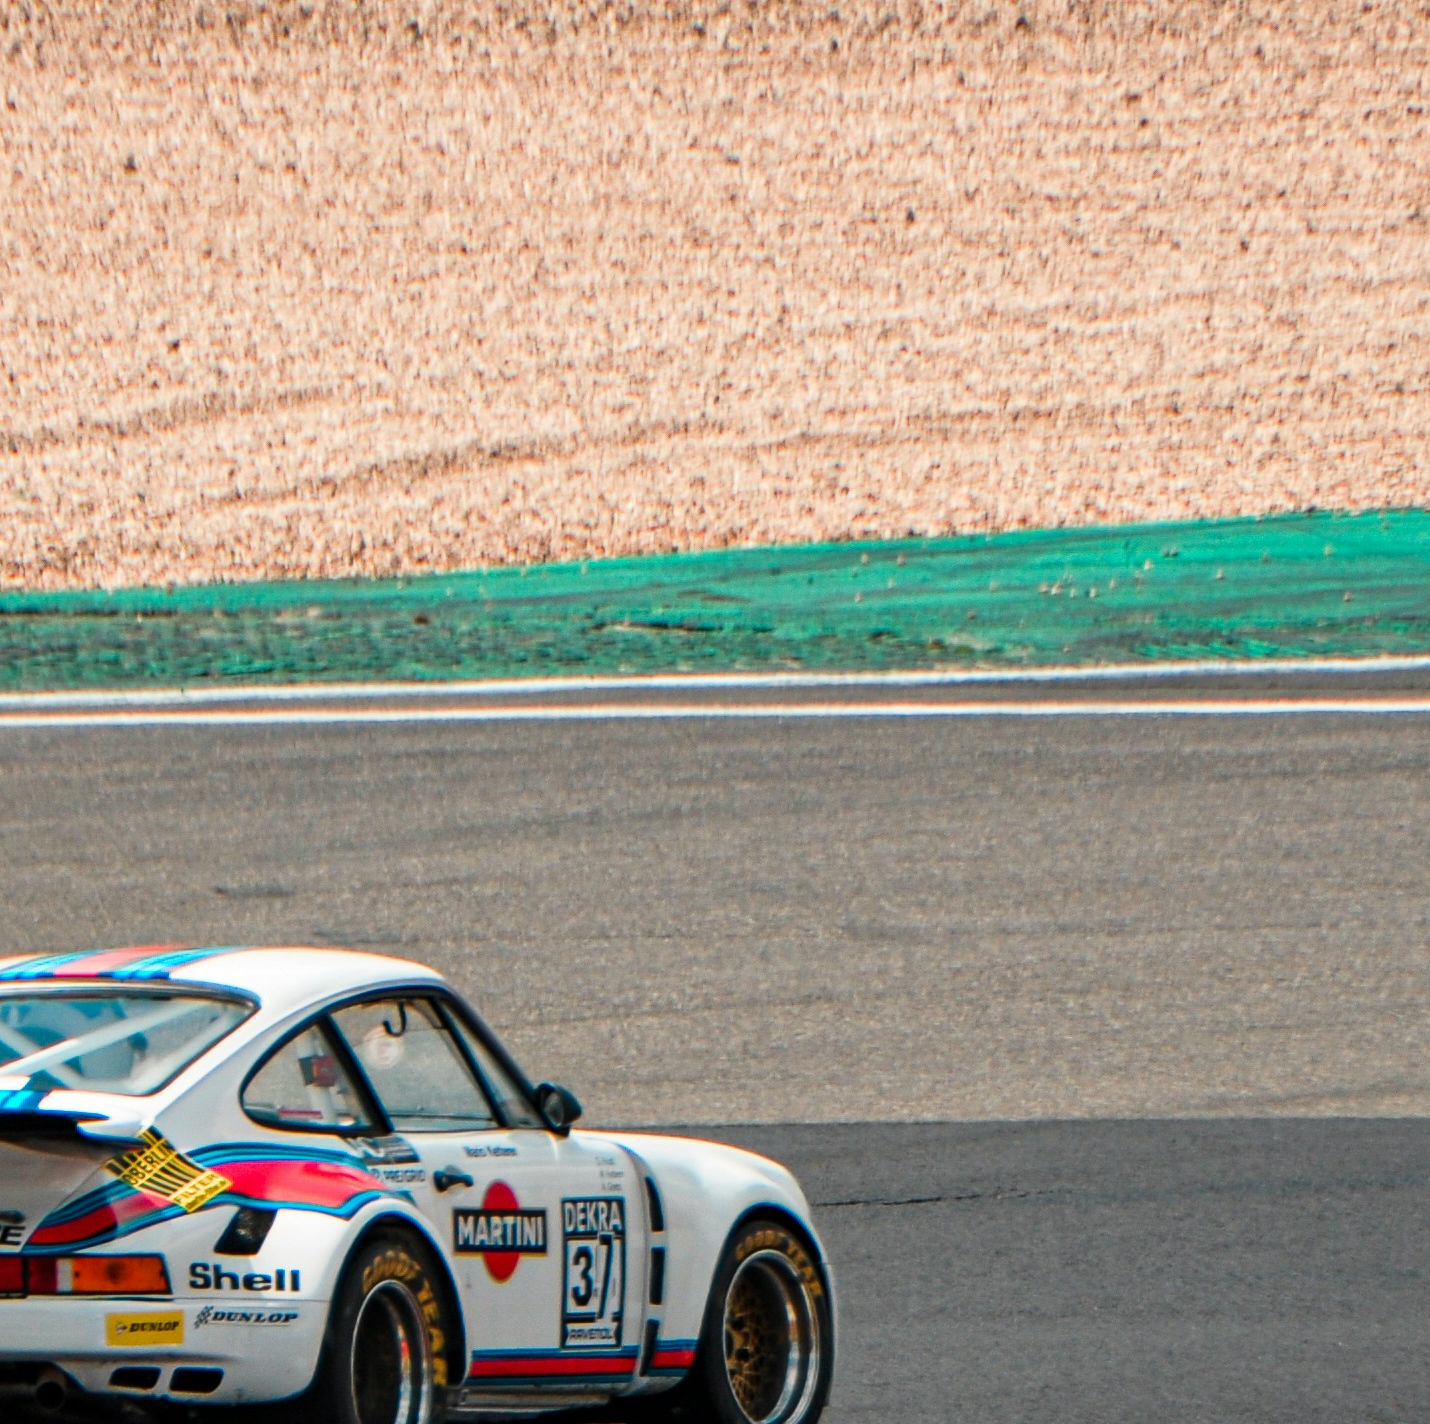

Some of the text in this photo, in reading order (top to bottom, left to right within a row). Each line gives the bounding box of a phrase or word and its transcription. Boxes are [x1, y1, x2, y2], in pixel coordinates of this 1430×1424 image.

[458, 1216, 544, 1246] MARTINI
[564, 1201, 622, 1232] DEKRA
[189, 1262, 300, 1291] Shell
[572, 1231, 613, 1319] 37
[129, 1320, 179, 1332] DUNLOP
[211, 1311, 298, 1323] DUNLOP
